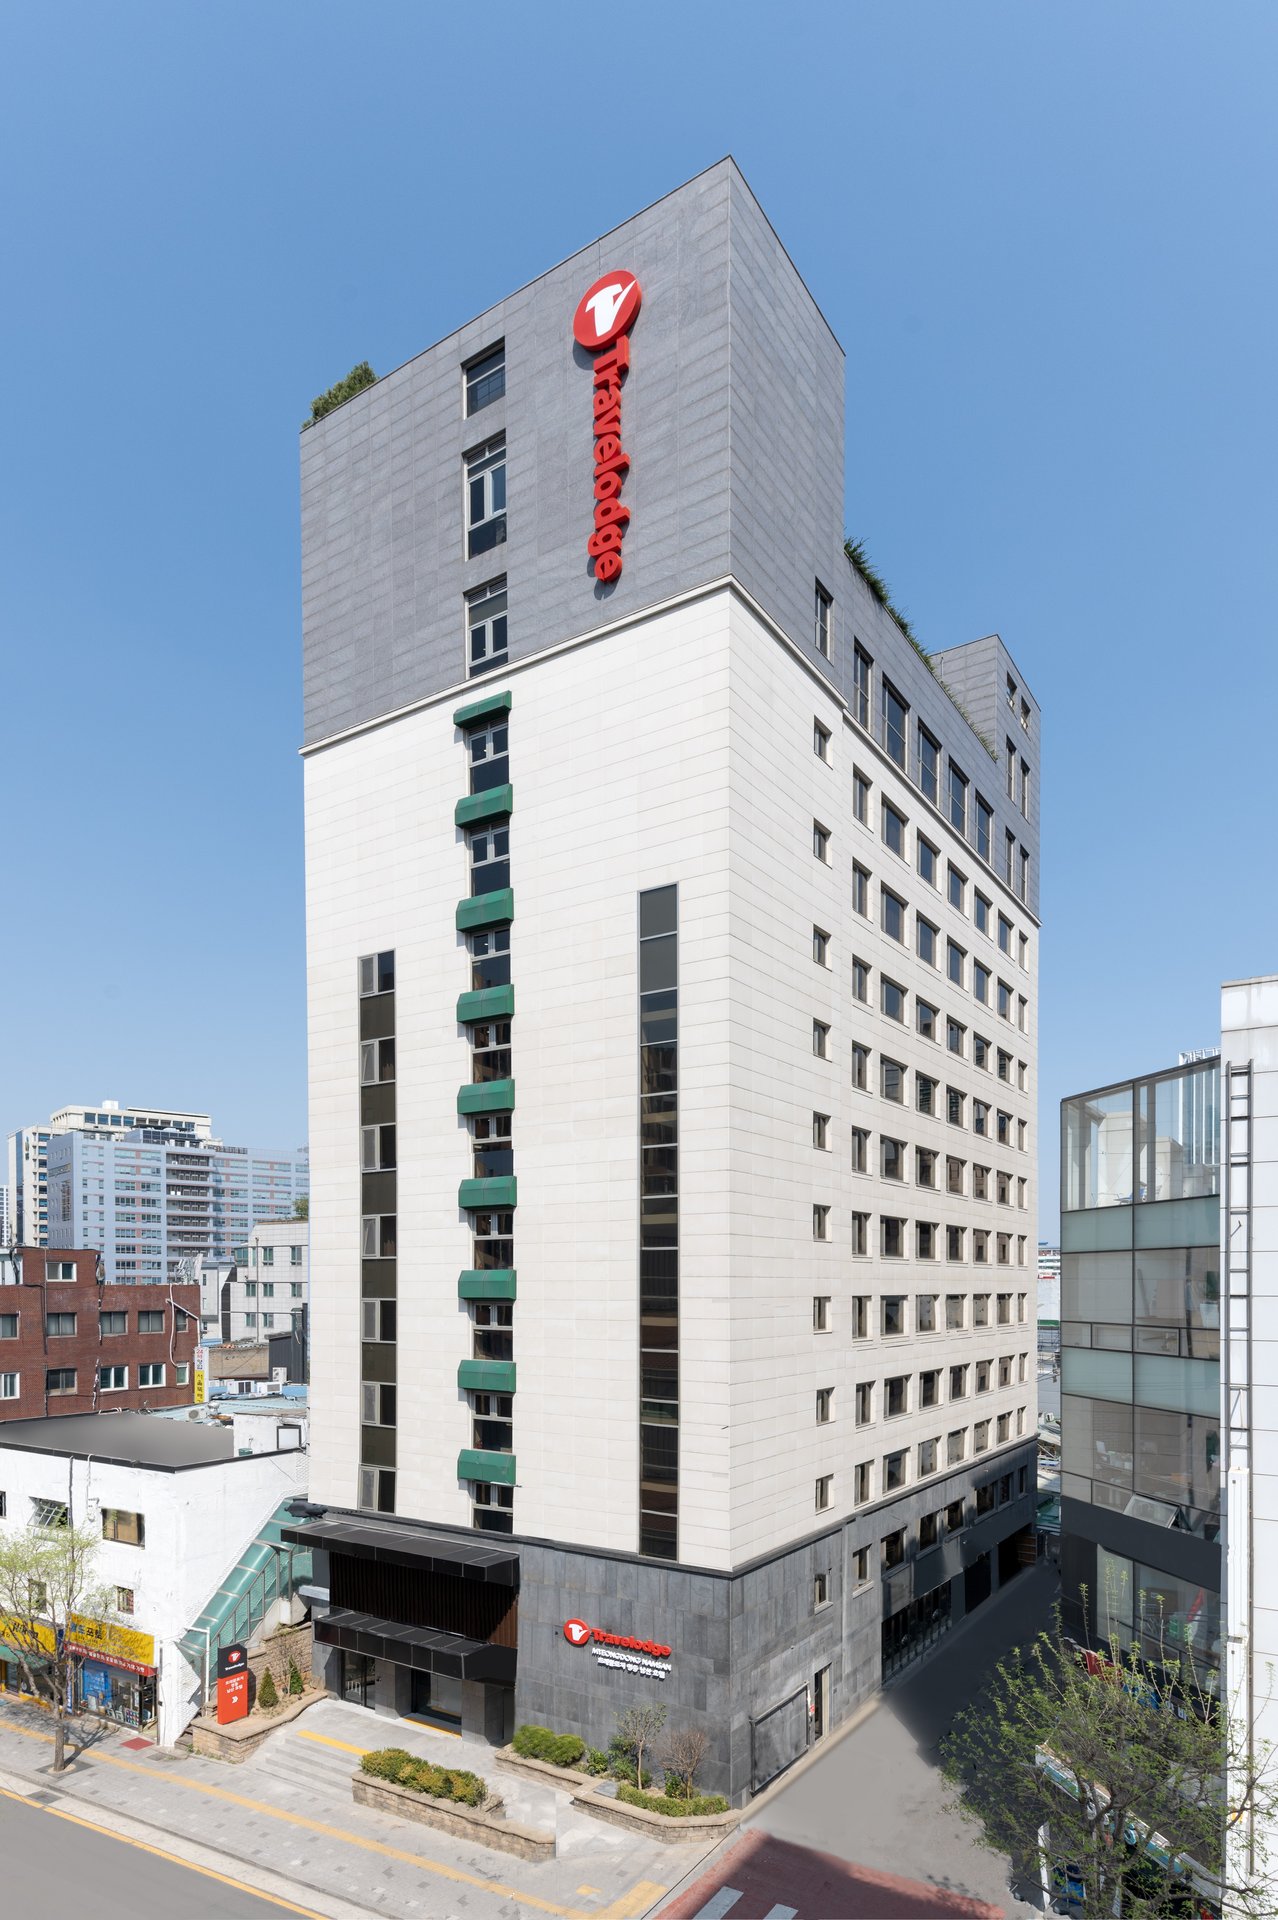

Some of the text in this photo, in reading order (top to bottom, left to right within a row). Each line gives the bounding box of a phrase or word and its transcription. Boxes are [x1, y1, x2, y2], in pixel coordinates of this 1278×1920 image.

[587, 335, 631, 583] Travelodge
[591, 1627, 672, 1657] Travelodge
[592, 1647, 672, 1672] MYEONGDONG NAMSAN
